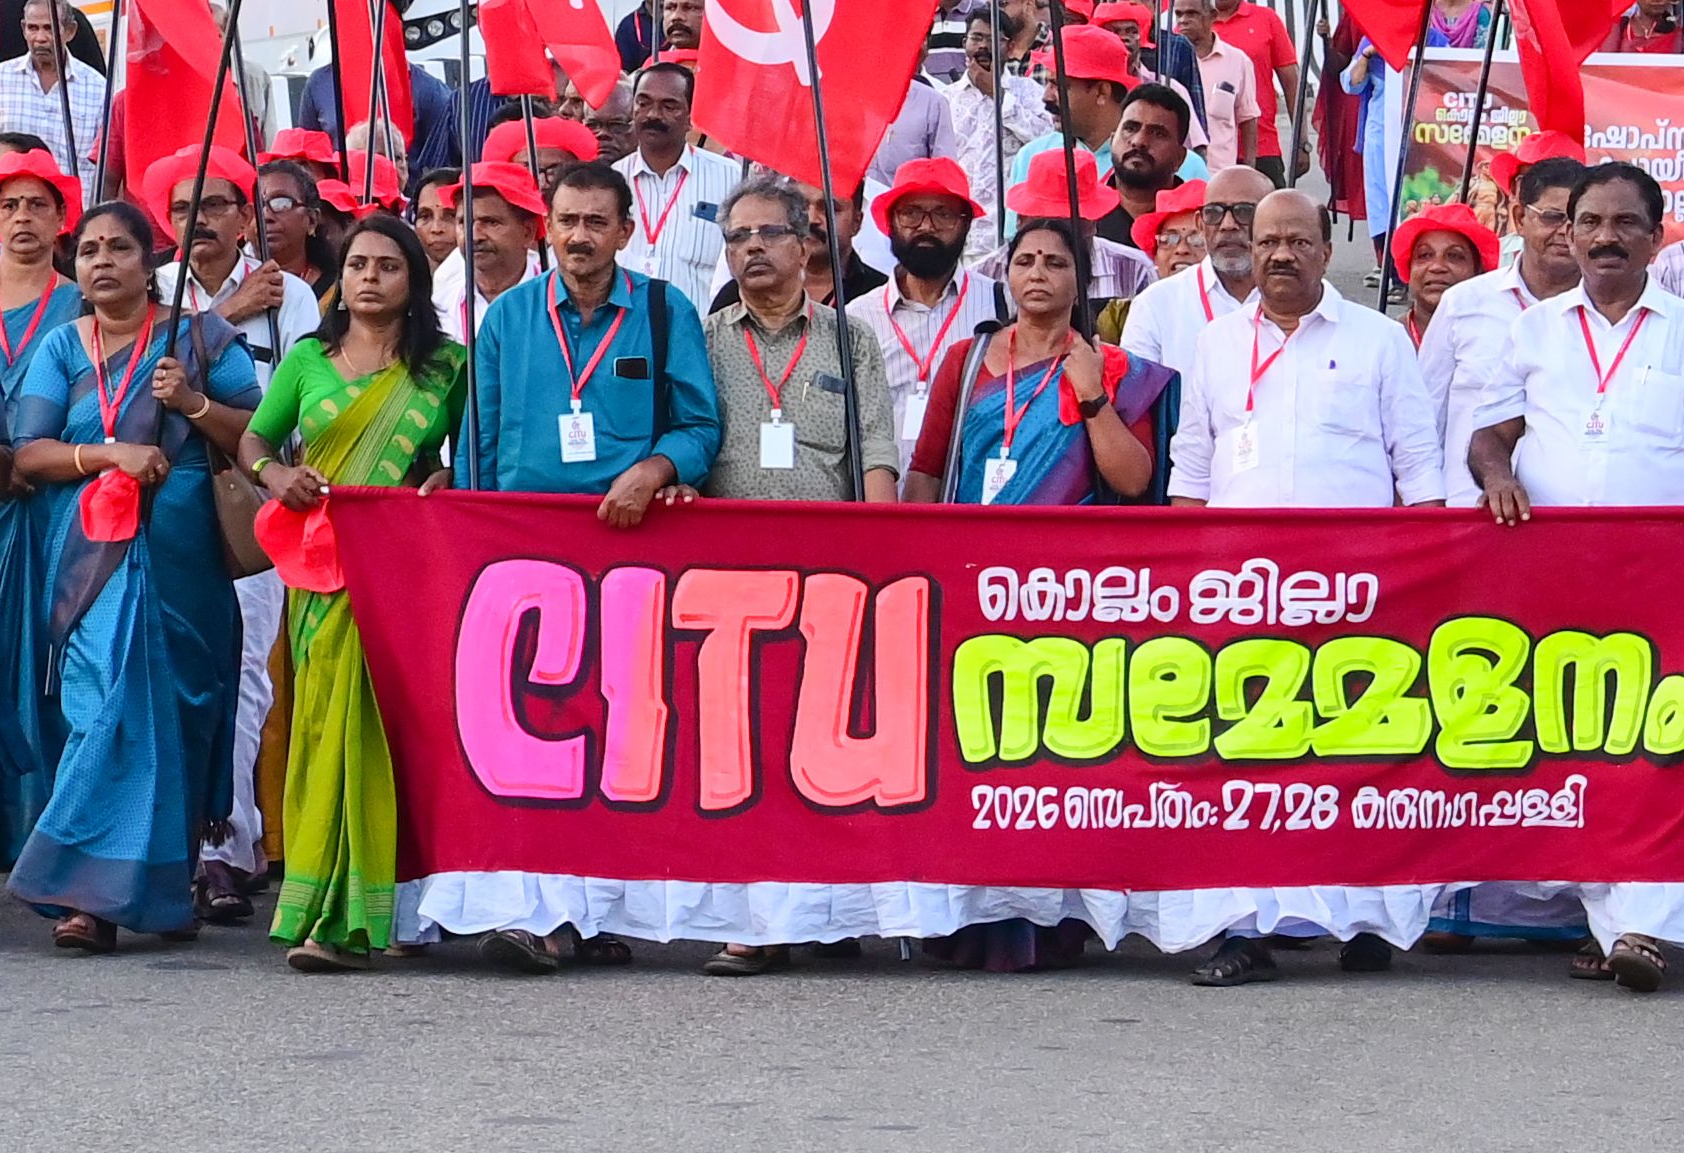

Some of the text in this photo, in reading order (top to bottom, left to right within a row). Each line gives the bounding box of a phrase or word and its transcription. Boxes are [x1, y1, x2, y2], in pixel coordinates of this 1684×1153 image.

[977, 557, 1378, 626] കൊല്ലം ജില്ലാ
[453, 556, 937, 813] CITU
[971, 784, 1059, 830] 2026
[1221, 779, 1339, 834] 27,28
[1351, 774, 1588, 830] കരുനാഗപ്പള്ളി
